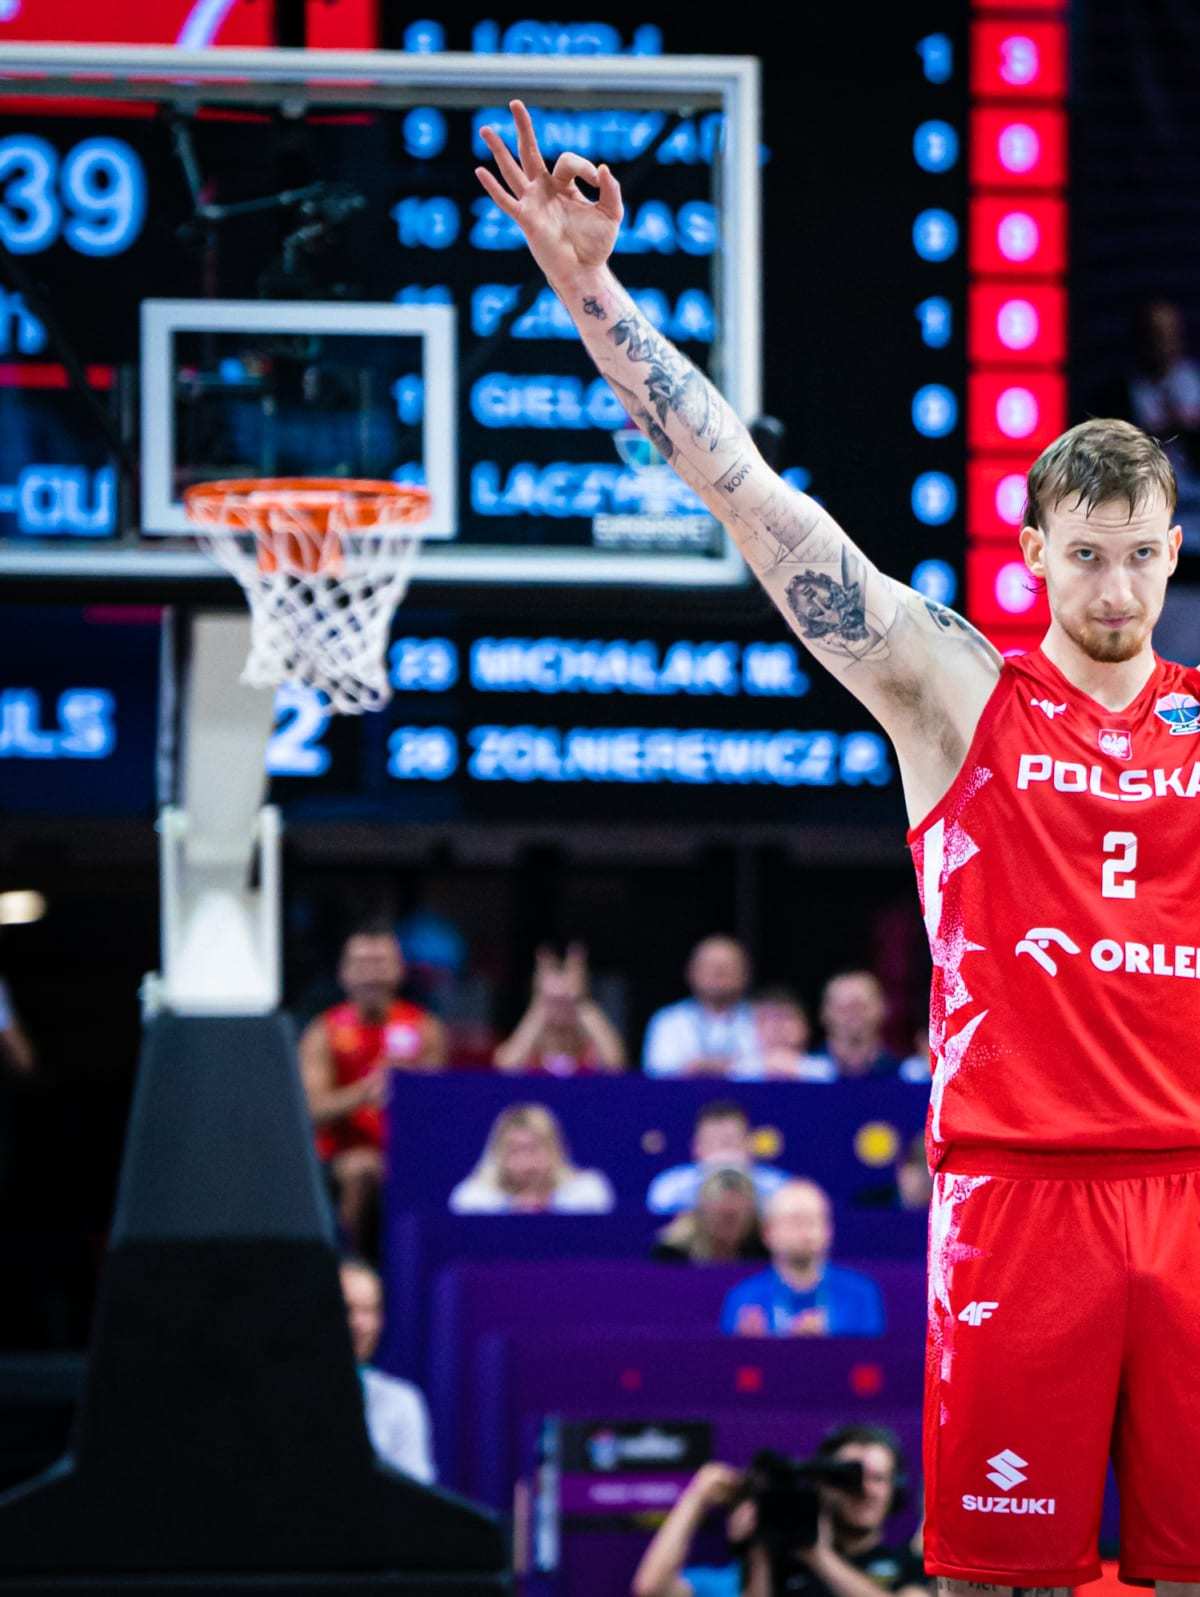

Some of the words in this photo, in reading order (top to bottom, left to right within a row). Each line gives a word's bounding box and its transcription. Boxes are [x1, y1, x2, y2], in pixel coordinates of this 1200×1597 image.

[914, 32, 953, 84] 1
[999, 34, 1040, 86] 3
[913, 295, 952, 348] 1
[389, 636, 458, 692] 23
[469, 637, 740, 695] MICHALAK
[387, 724, 458, 780] 28
[467, 724, 839, 786] ZOLNIEREWICZ
[1101, 831, 1138, 899] 2
[958, 1301, 1000, 1326] 4F
[962, 1494, 1056, 1515] SUZUKI
